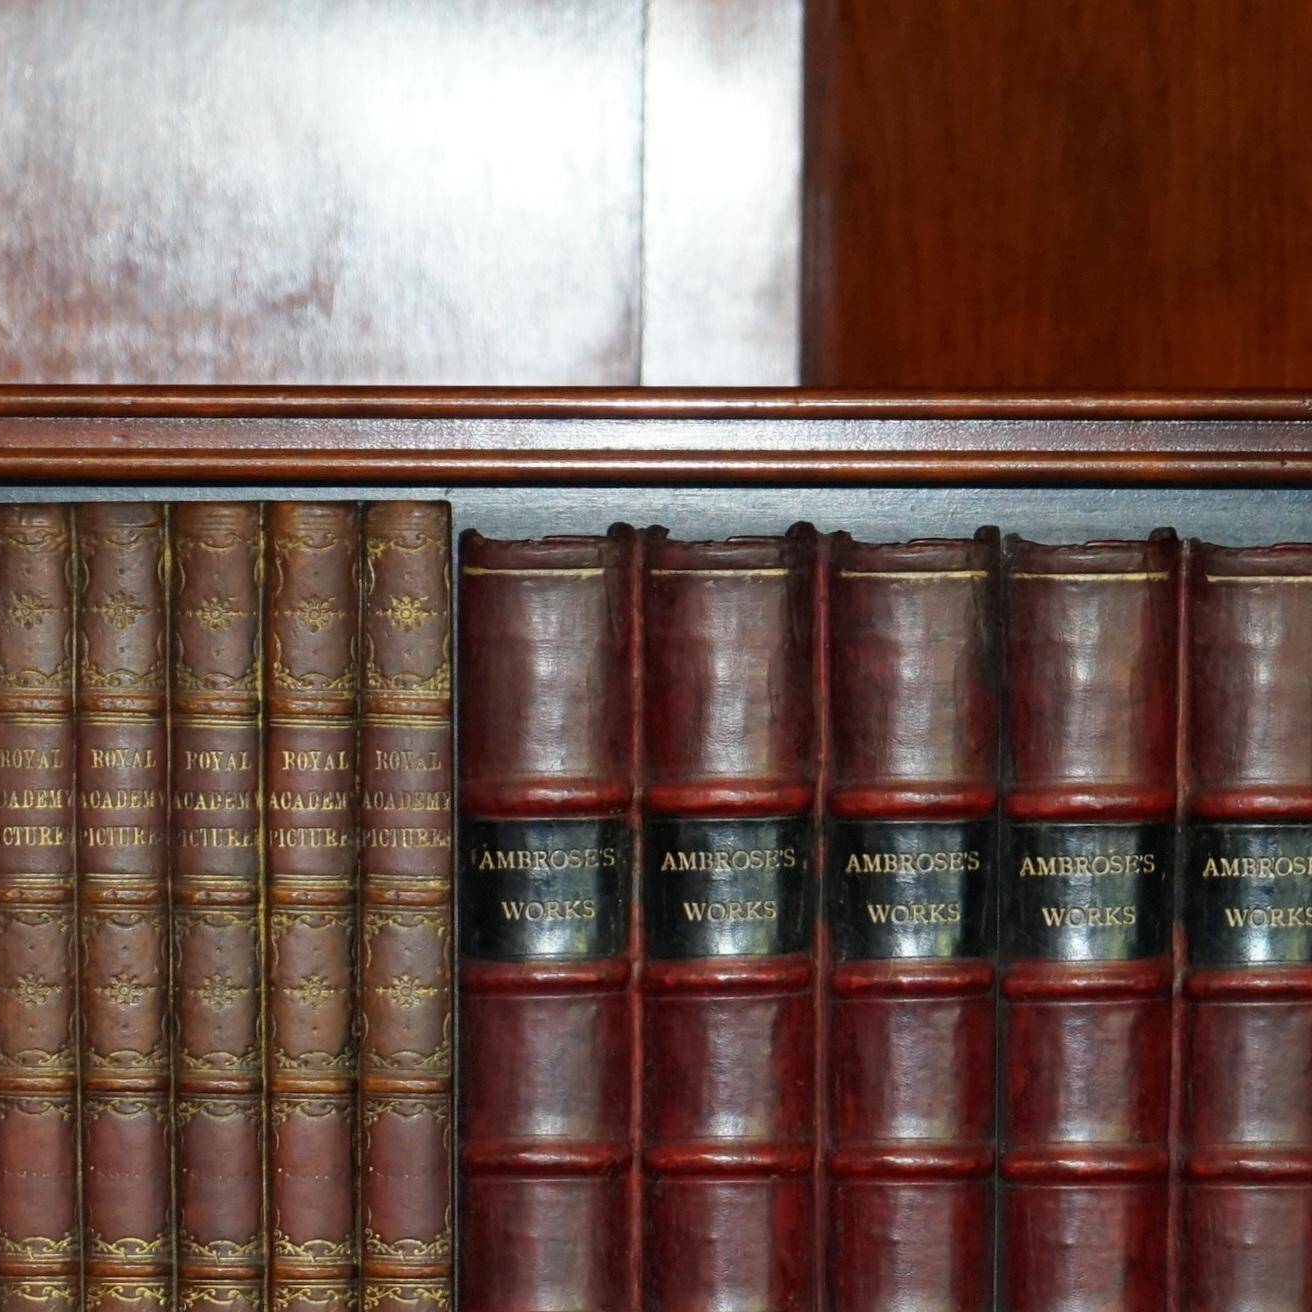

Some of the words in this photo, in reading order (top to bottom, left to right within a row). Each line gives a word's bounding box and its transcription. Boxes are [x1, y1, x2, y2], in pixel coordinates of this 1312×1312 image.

[0, 749, 64, 770] ROYAL
[91, 749, 157, 770] ROYAL
[282, 749, 350, 771] ROYAL
[375, 750, 443, 771] ROYAL
[269, 791, 355, 812] ACADEM
[478, 848, 616, 871] AMBROSE'S
[660, 848, 797, 872] AMBROSE'S
[845, 851, 981, 874] AMBROSE'S
[1019, 852, 1157, 877] AMBROSE'S
[501, 899, 597, 922] WORKS
[684, 900, 778, 923] WORKS
[867, 902, 962, 926] WORKS
[1041, 904, 1137, 928] WORKS
